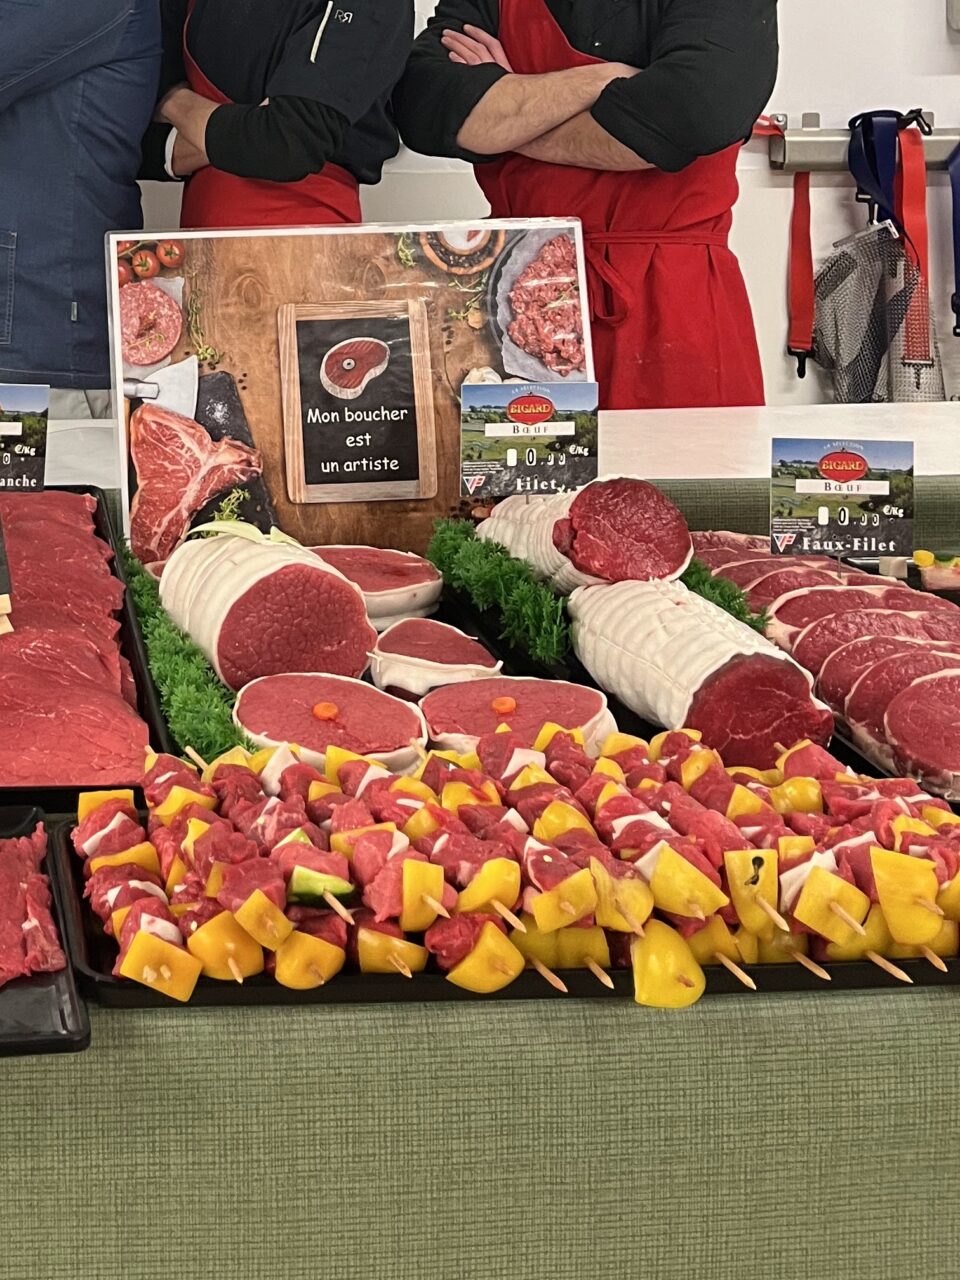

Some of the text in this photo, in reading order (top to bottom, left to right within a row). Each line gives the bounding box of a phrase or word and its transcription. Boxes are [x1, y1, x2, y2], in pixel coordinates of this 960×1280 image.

[307, 406, 408, 424] Mon boucher
[510, 404, 551, 414] BIGARD
[345, 432, 372, 447] est
[321, 456, 400, 473] un artiste
[821, 461, 865, 471] BIGARD
[516, 476, 557, 490] Filet
[802, 537, 896, 552] Faux-Filet
